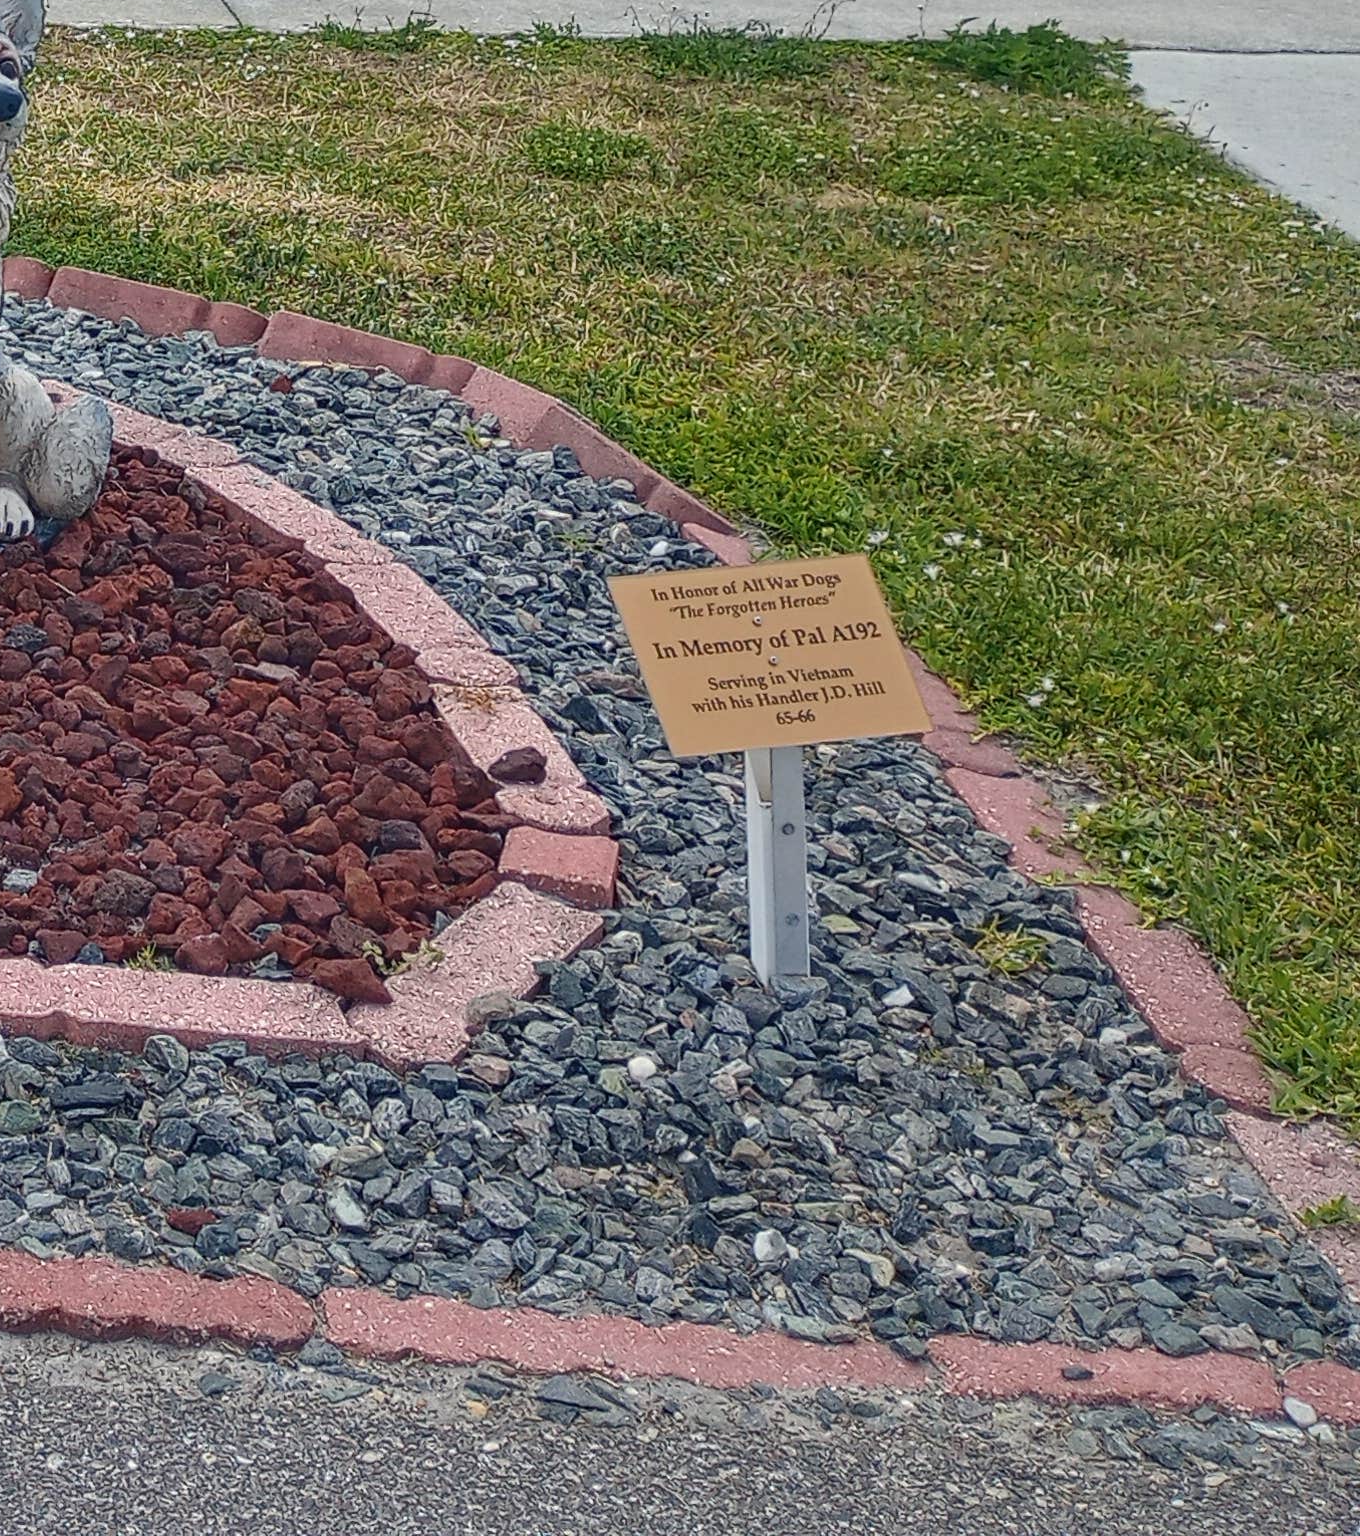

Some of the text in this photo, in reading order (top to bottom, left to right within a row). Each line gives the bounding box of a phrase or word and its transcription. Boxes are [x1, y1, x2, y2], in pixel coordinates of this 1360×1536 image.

[651, 573, 841, 601] In Honor of All War Dogs
[707, 599, 777, 619] Forgotten
[652, 621, 882, 660] In Memory of Pal A192
[707, 666, 854, 691] Serving in Vietnam
[691, 682, 886, 713] with his Handler J.D. Hill
[776, 710, 816, 725] 65-66
